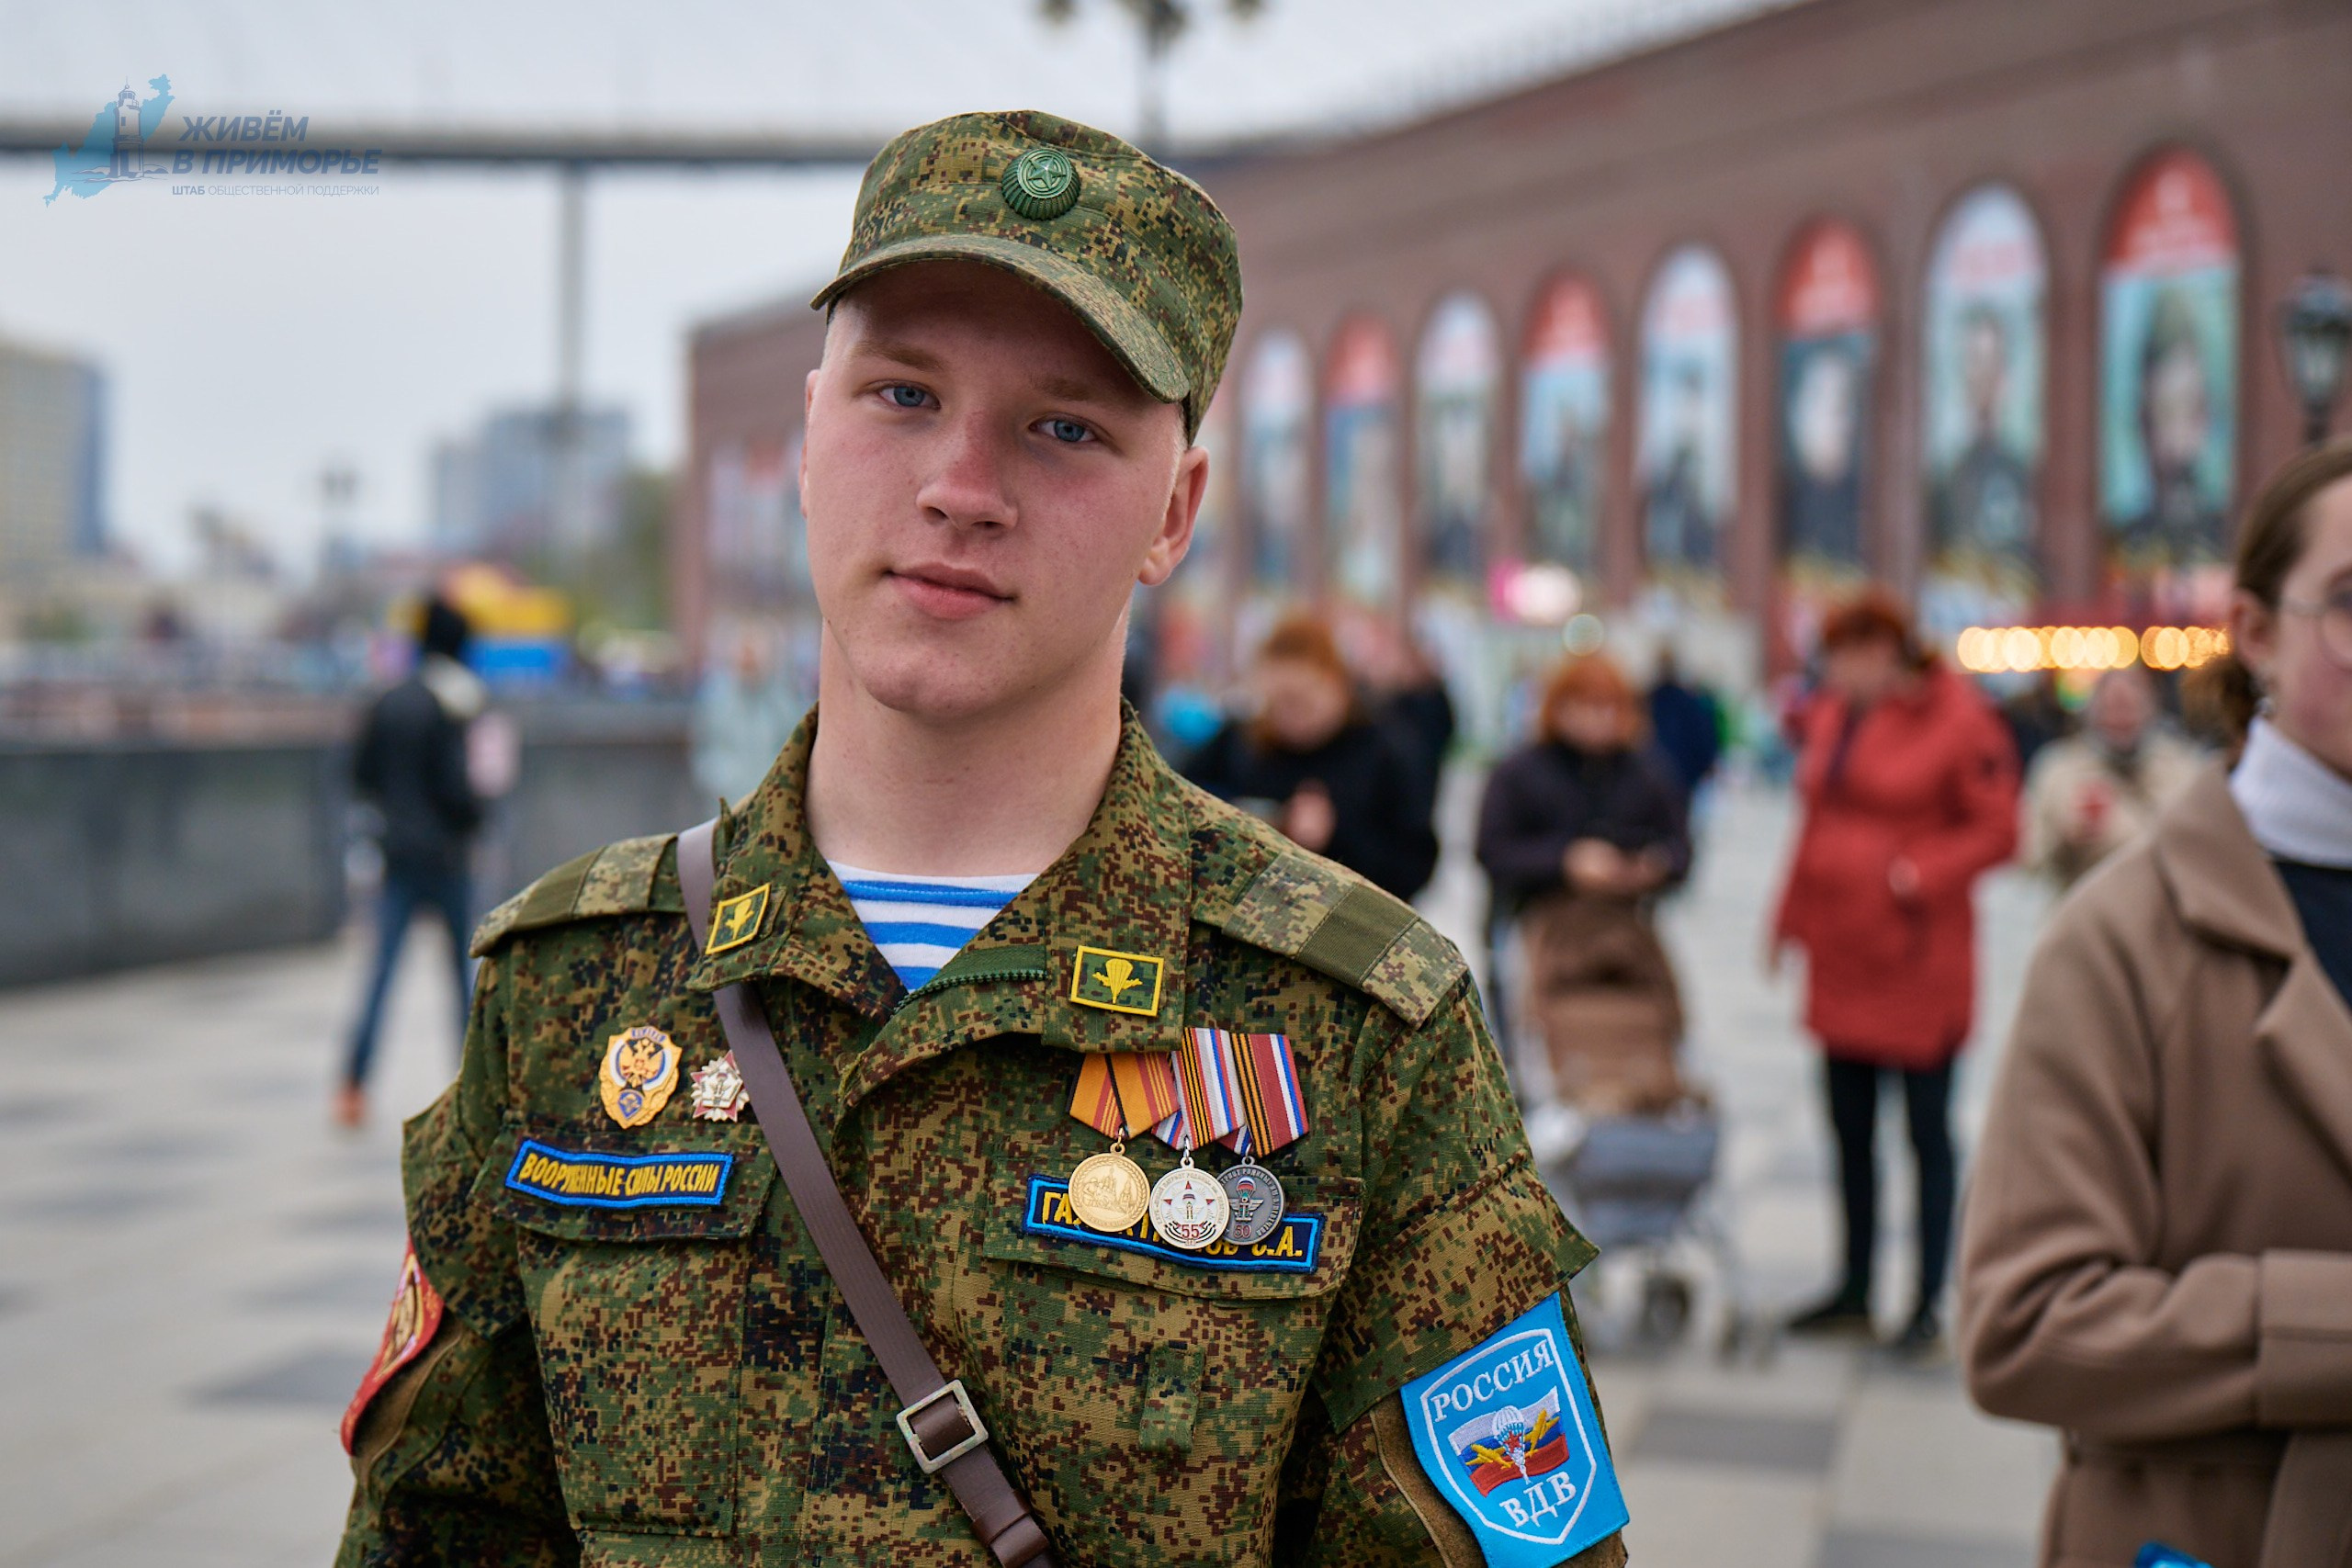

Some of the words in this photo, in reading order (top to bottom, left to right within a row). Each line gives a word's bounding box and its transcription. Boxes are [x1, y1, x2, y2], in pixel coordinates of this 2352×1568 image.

[625, 1165, 664, 1196] СИЛЫ
[661, 1163, 720, 1192] РОССИИ
[1182, 1224, 1200, 1238] 55
[1234, 1224, 1251, 1239] 50
[1430, 1338, 1555, 1422] РОССИЯ
[1499, 1471, 1577, 1528] ВДВ
